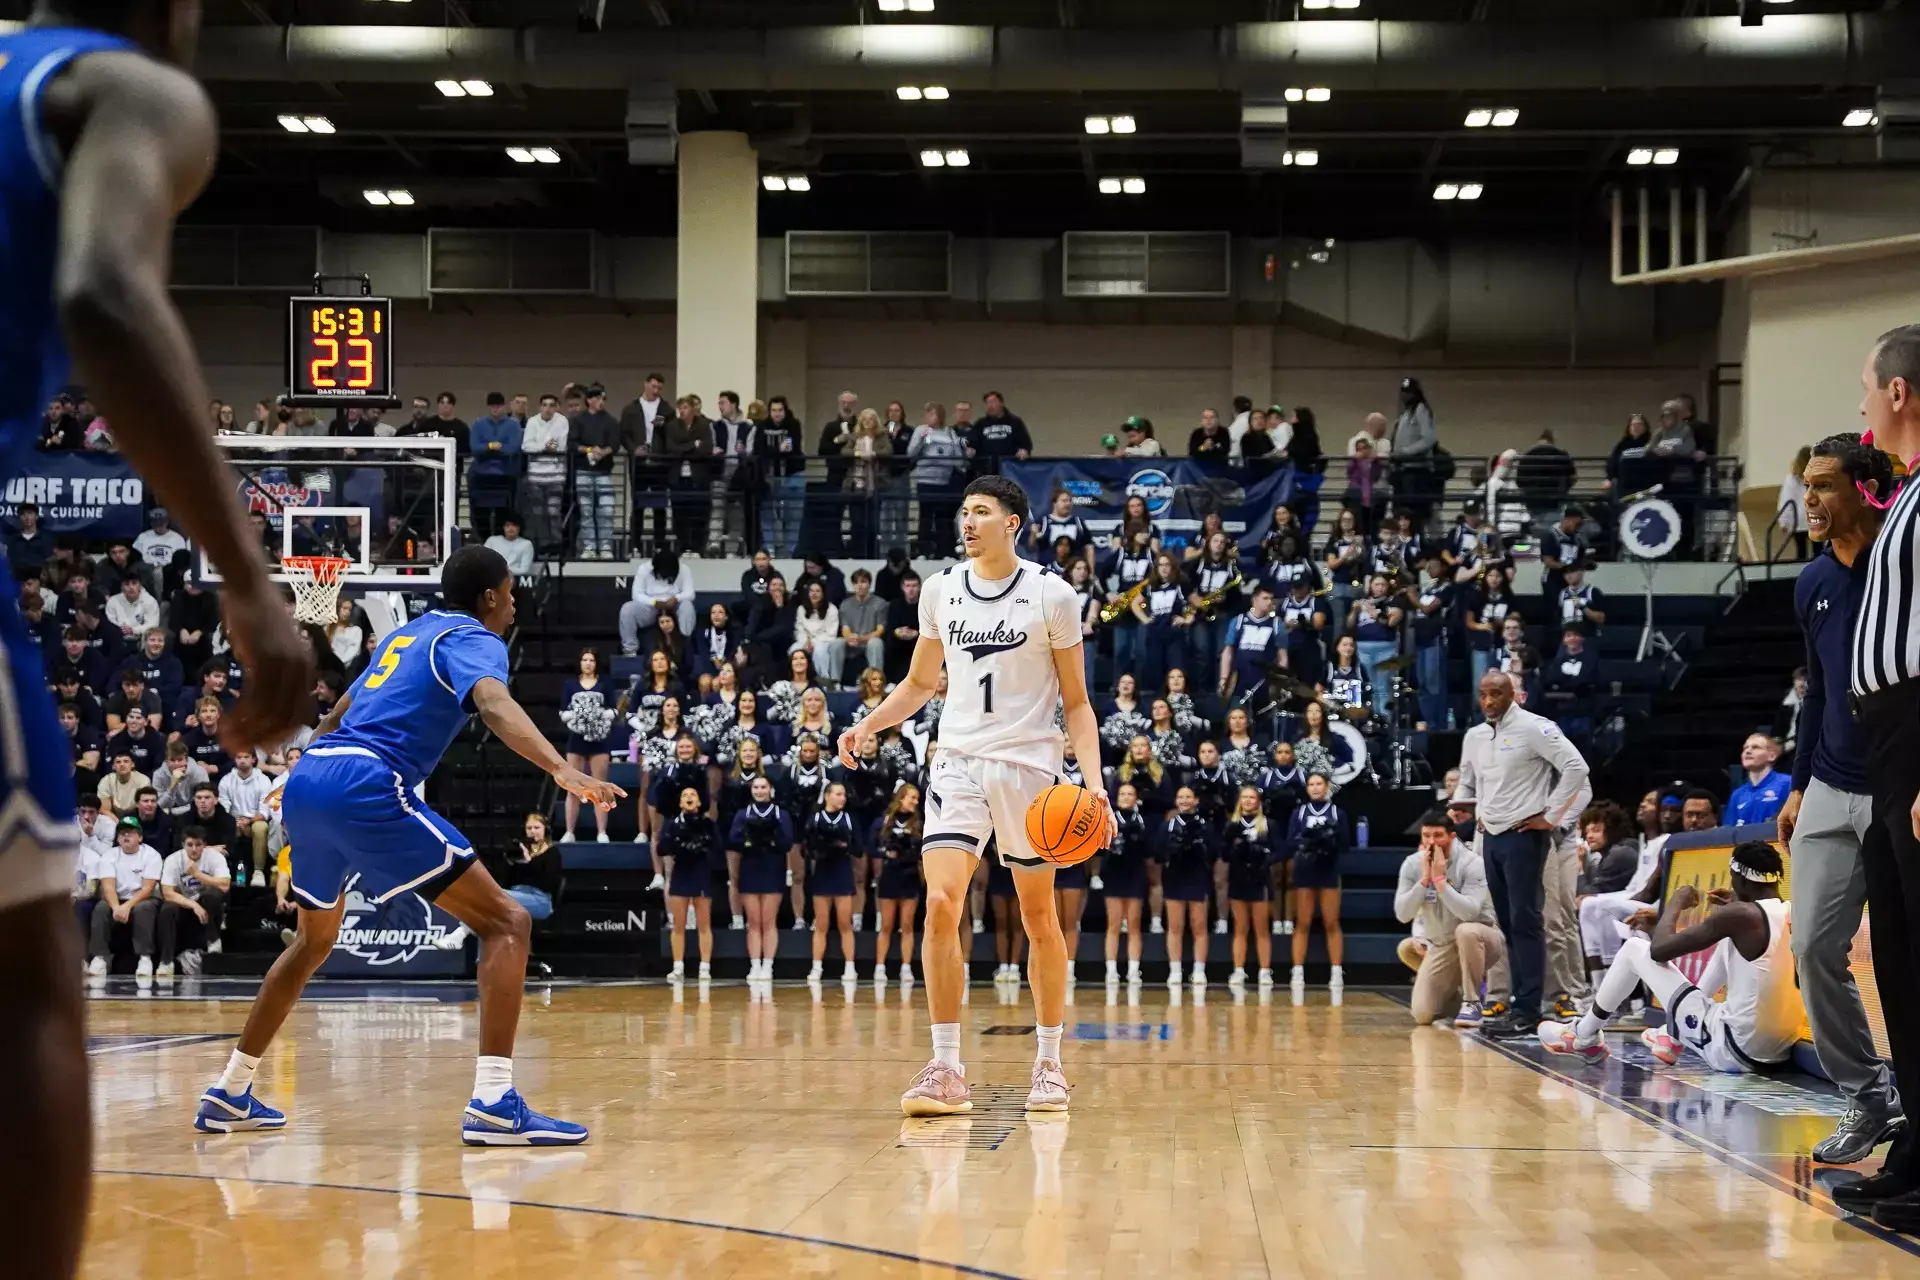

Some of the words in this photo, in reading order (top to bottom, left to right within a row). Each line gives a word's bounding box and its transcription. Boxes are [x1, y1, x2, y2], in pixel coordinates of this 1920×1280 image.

[313, 308, 380, 335] 15:31
[311, 338, 373, 387] 23
[0, 477, 62, 504] URF
[70, 478, 142, 505] TACO
[1125, 484, 1174, 497] Circle
[50, 507, 103, 518] CUISINE
[519, 576, 533, 588] M
[615, 576, 627, 588] N
[948, 619, 1027, 646] Hawks
[364, 635, 417, 689] 5
[978, 672, 994, 714] 1
[585, 919, 625, 931] Section
[627, 909, 646, 931] N
